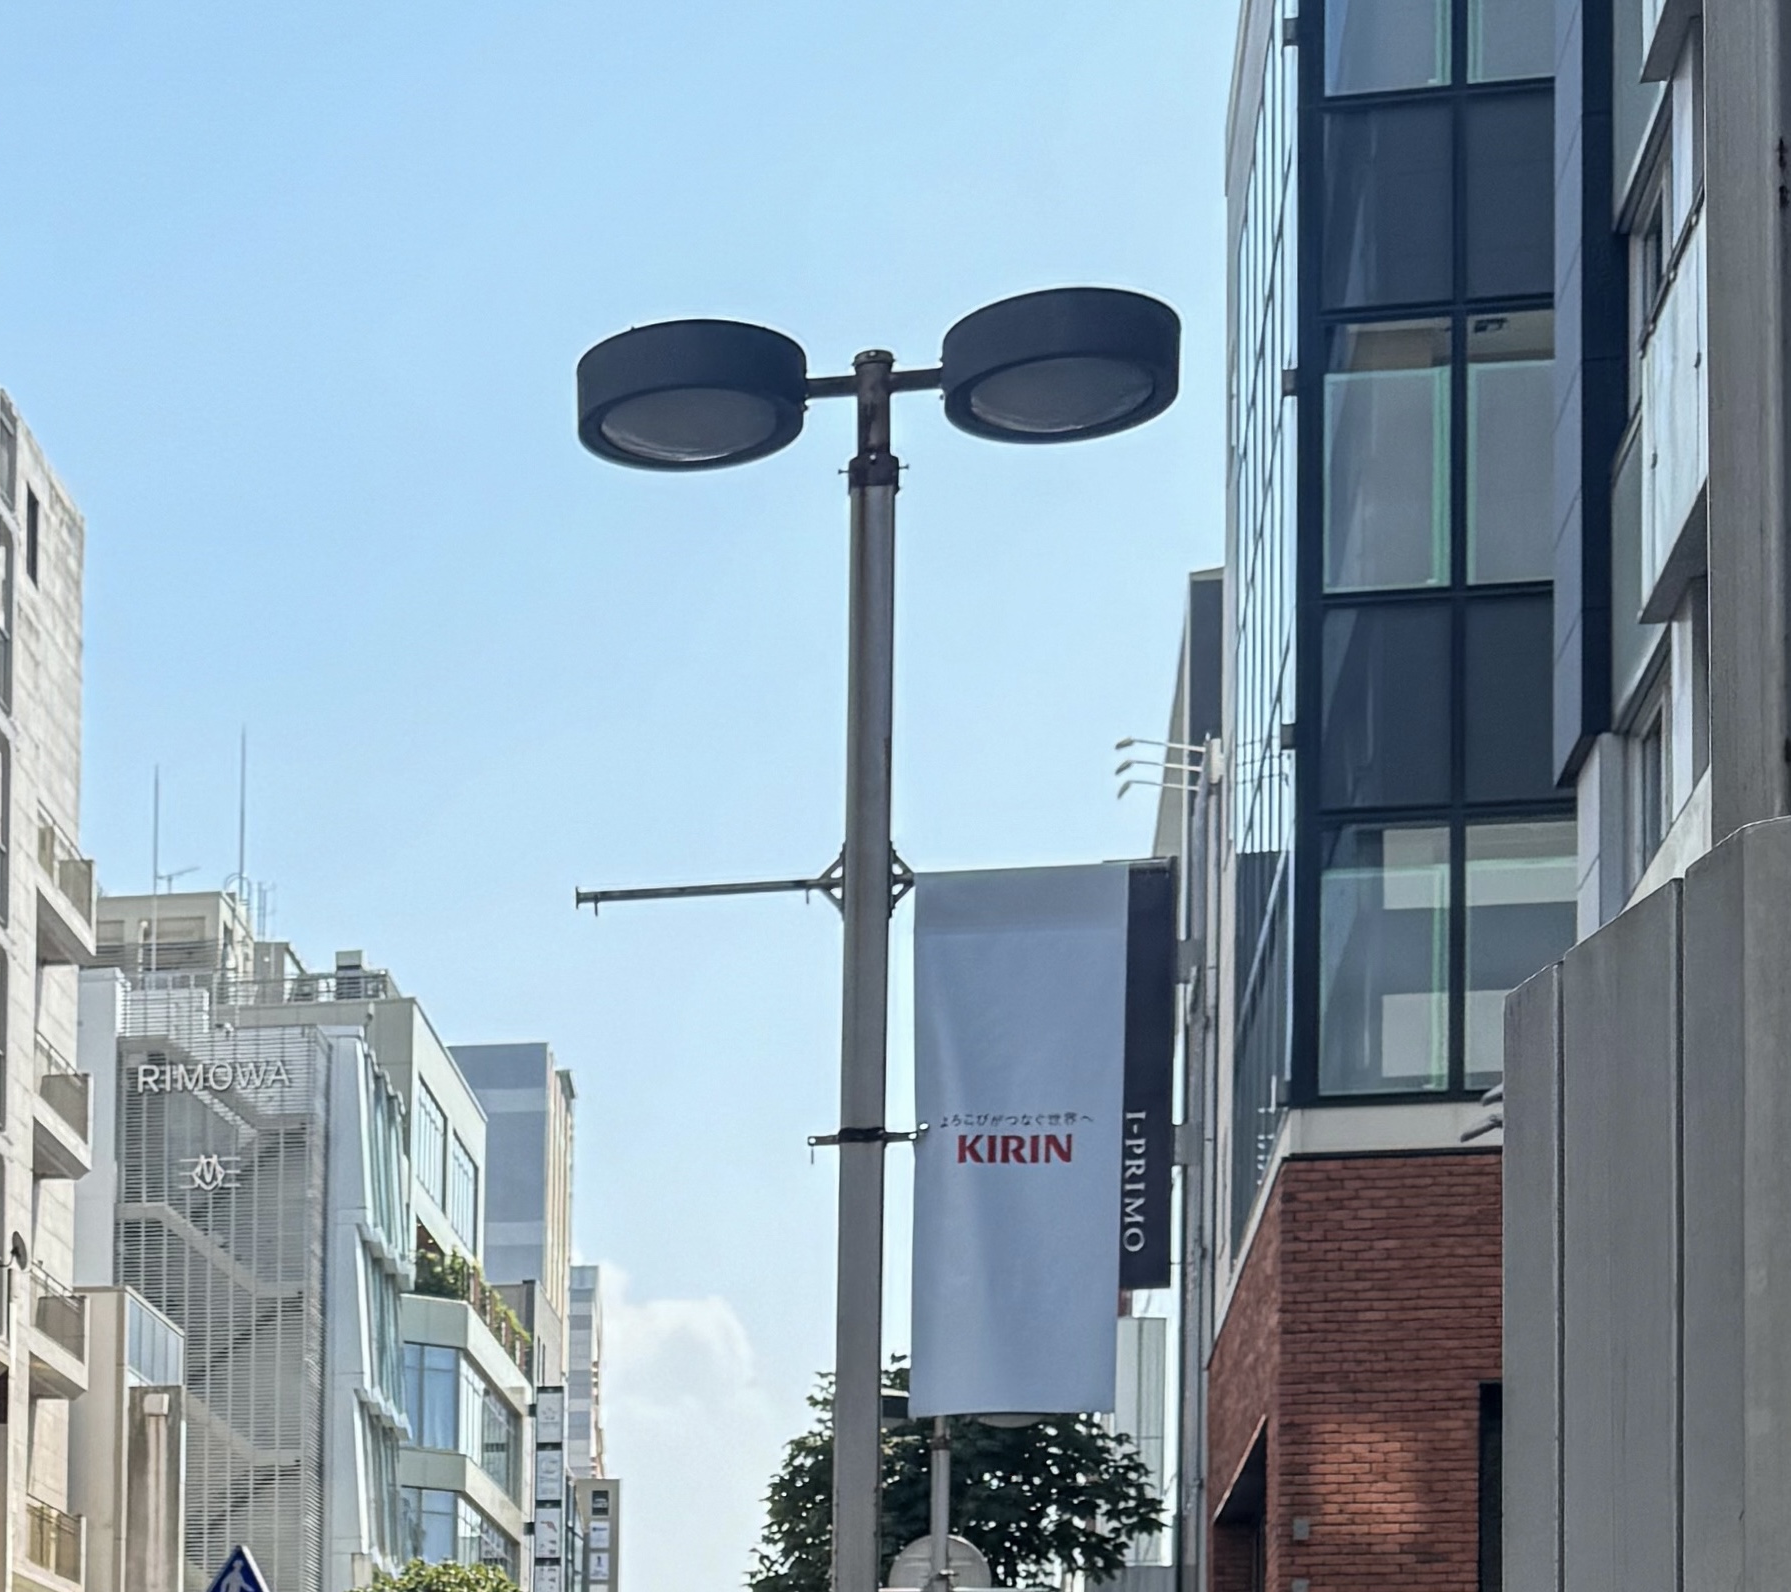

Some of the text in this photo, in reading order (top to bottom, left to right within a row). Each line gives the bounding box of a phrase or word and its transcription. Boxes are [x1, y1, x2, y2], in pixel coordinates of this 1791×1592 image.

[136, 1060, 291, 1095] RIMOWA
[940, 1111, 1095, 1129] よろこびがつなぐ世界へ
[957, 1133, 1073, 1164] KIRIN
[1123, 1111, 1147, 1254] I-PRIMO
